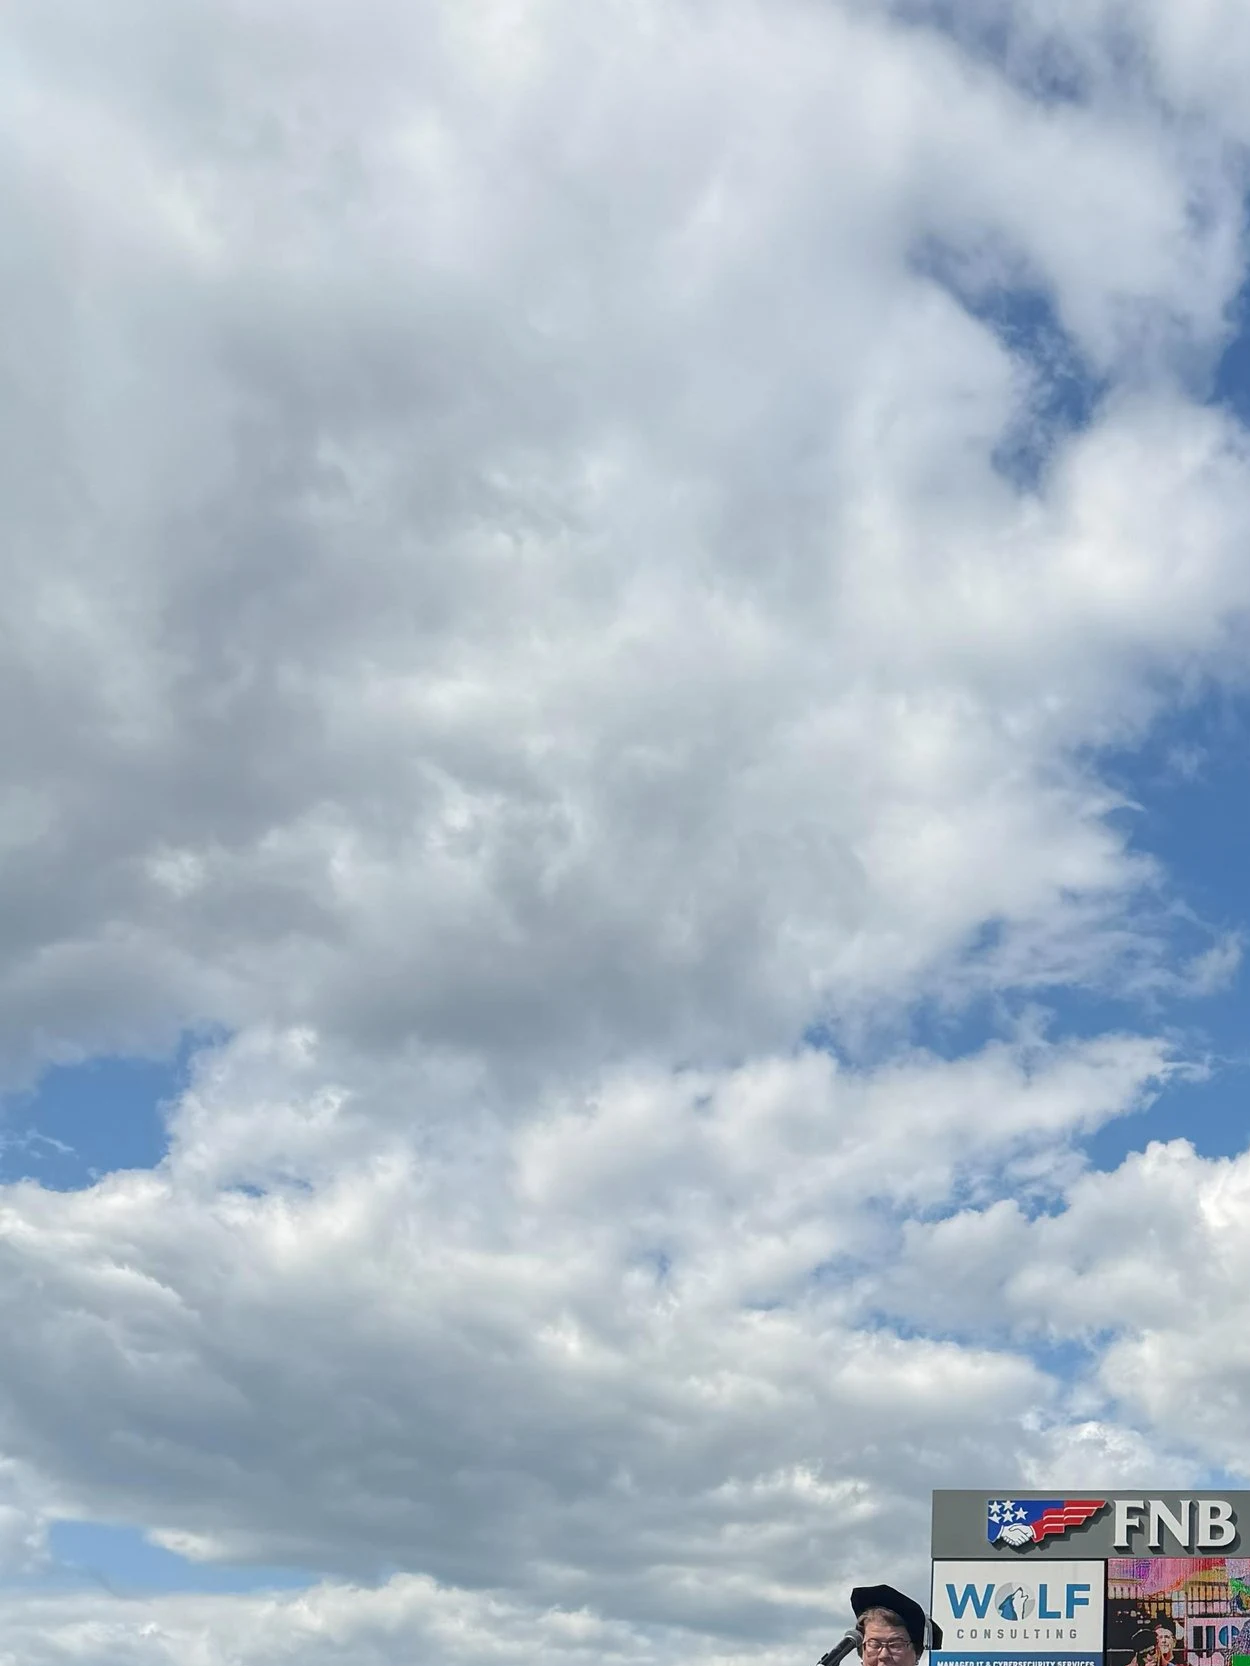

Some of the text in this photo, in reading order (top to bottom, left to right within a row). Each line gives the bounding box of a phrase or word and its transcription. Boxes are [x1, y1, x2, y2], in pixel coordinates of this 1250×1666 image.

[1113, 1500, 1236, 1547] FNB
[945, 1582, 1091, 1621] WOLF
[957, 1629, 1077, 1639] CONSULTING
